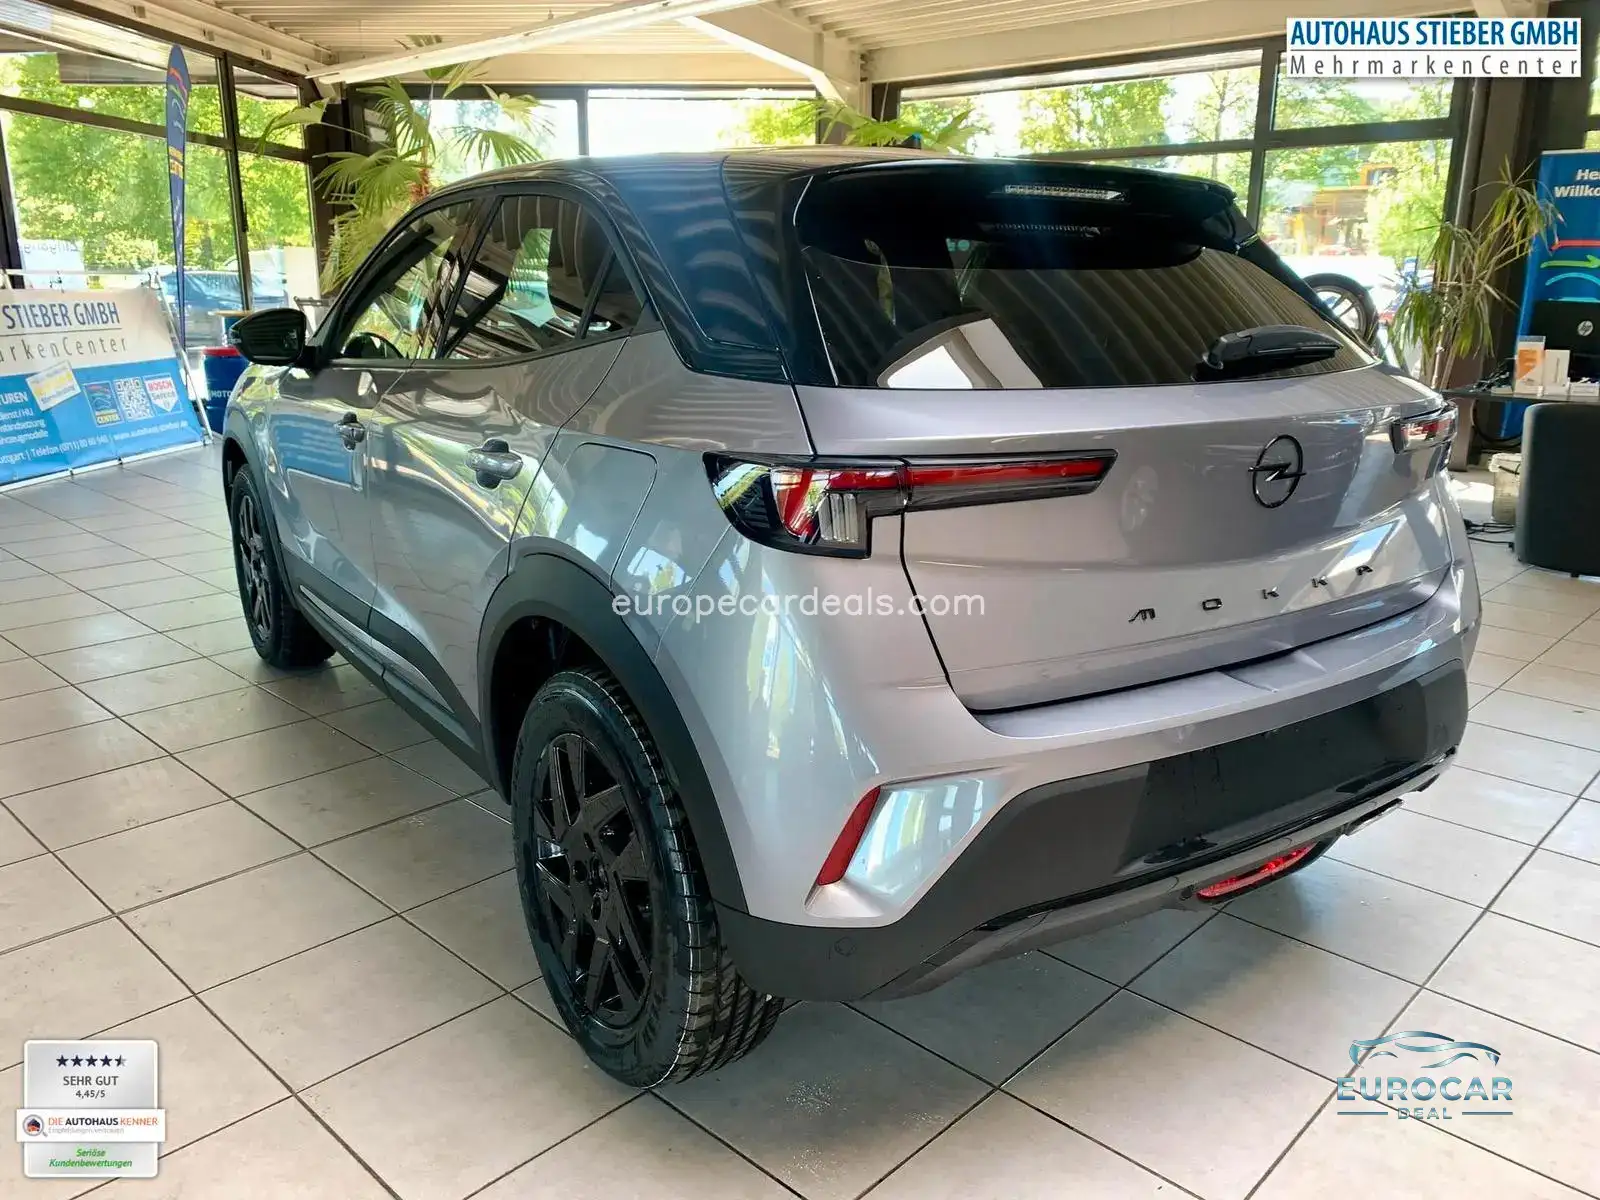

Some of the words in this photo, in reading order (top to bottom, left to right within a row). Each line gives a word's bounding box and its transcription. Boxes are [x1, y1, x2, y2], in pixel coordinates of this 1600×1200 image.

[1576, 168, 1600, 180] He
[2, 303, 72, 330] STIEBER
[73, 301, 120, 325] GMBH
[148, 380, 173, 392] BOSCH
[0, 391, 28, 405] UREN
[1128, 564, 1373, 623] MOKKA
